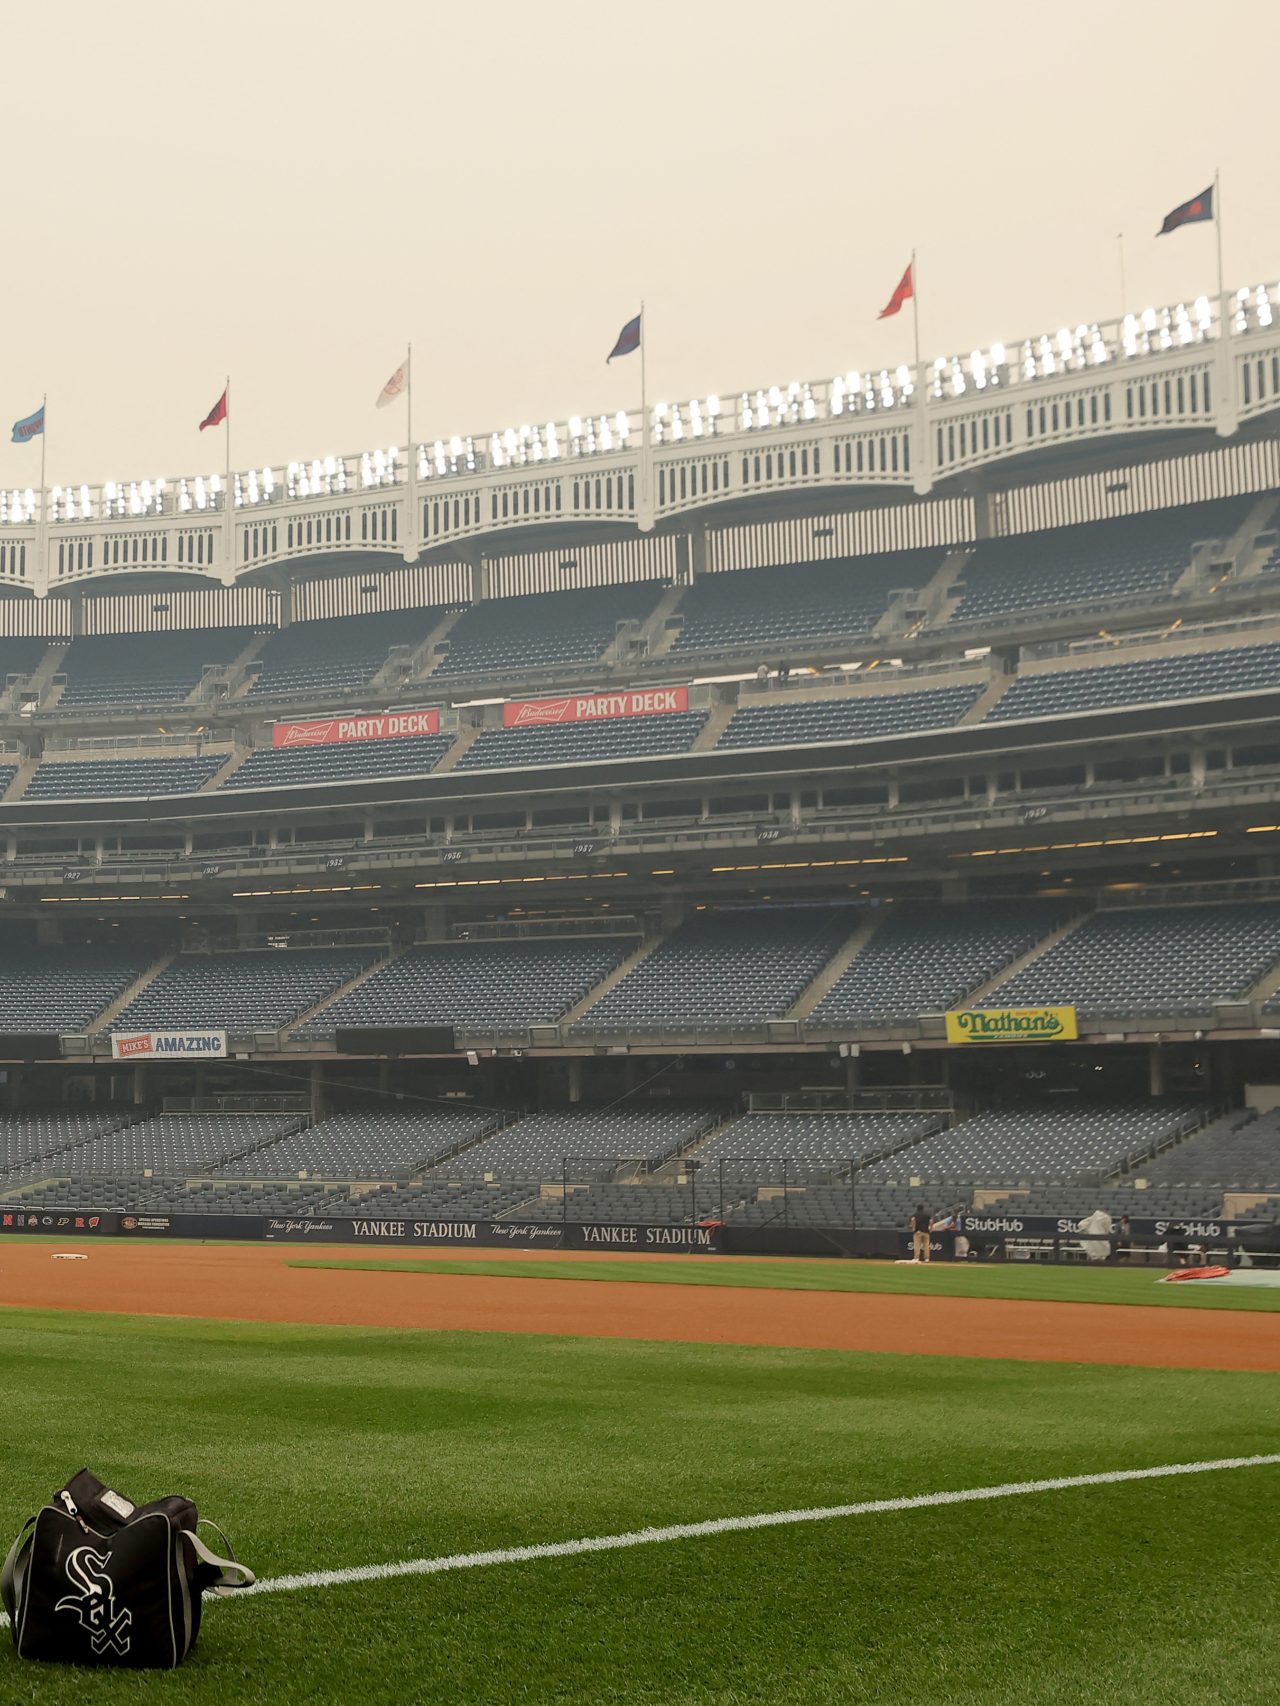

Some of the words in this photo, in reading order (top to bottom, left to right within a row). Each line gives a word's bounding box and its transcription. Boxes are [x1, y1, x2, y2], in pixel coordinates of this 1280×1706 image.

[576, 696, 627, 717] PARTY
[632, 691, 676, 712] DECK
[338, 718, 386, 739] PARTY
[388, 714, 428, 734] DECK
[957, 1011, 1060, 1033] Nathan's
[122, 1040, 149, 1053] MIKE'S
[155, 1037, 221, 1052] AMAZING
[285, 1220, 303, 1233] York
[304, 1221, 333, 1234] Yankees
[352, 1221, 405, 1237] YANKEE
[414, 1222, 476, 1239] STADIUM
[509, 1224, 528, 1239] York
[529, 1225, 561, 1239] Yankees
[965, 1217, 1023, 1232] StubHub
[582, 1226, 638, 1243] YANKEE
[646, 1227, 711, 1245] STADIUM
